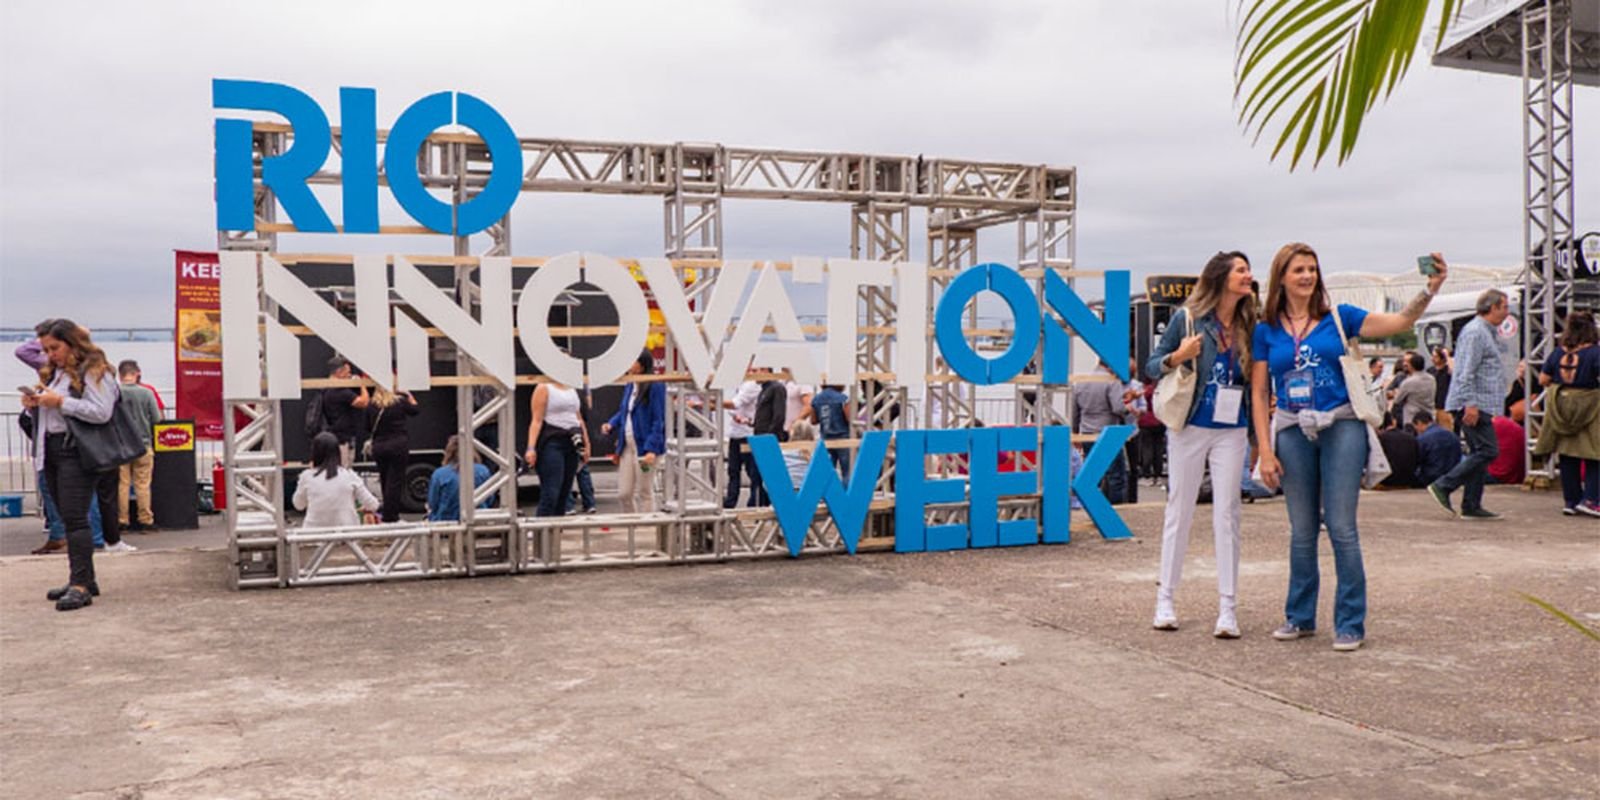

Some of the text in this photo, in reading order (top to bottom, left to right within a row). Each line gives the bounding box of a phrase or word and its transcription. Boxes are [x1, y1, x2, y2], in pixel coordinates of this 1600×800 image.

[212, 78, 523, 237] RIO
[219, 250, 1130, 400] INNOVATION
[1160, 283, 1183, 298] LAS
[747, 424, 1137, 558] WEEK
